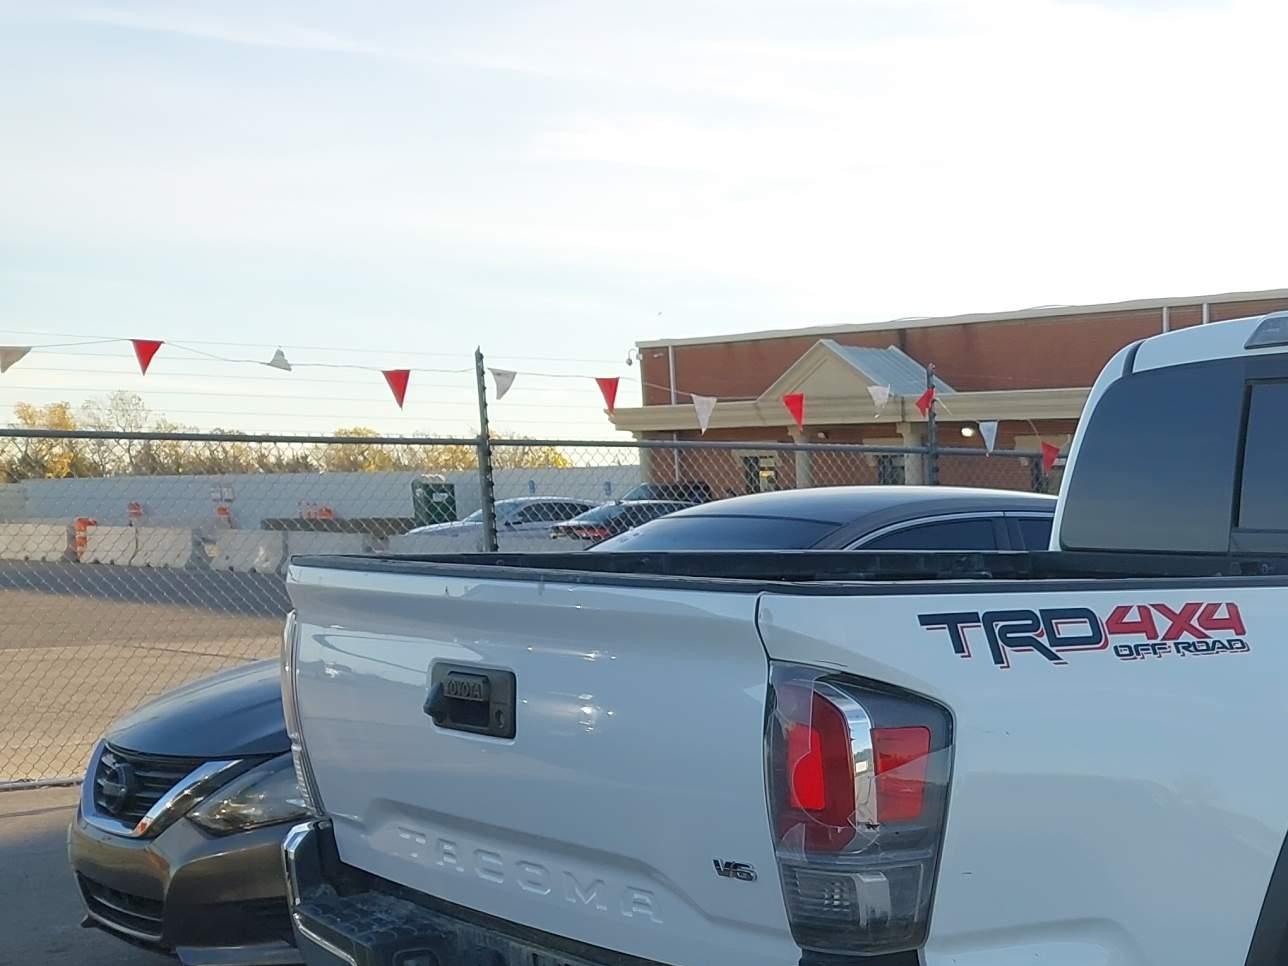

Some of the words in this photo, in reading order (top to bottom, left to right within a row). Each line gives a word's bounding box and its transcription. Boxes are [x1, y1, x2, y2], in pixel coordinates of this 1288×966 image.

[917, 606, 1108, 669] TRD
[1104, 602, 1248, 641] 4X4
[1114, 641, 1172, 661] OFF
[1176, 637, 1251, 657] ROAD
[398, 826, 664, 924] TACOMA
[711, 858, 758, 882] V6
